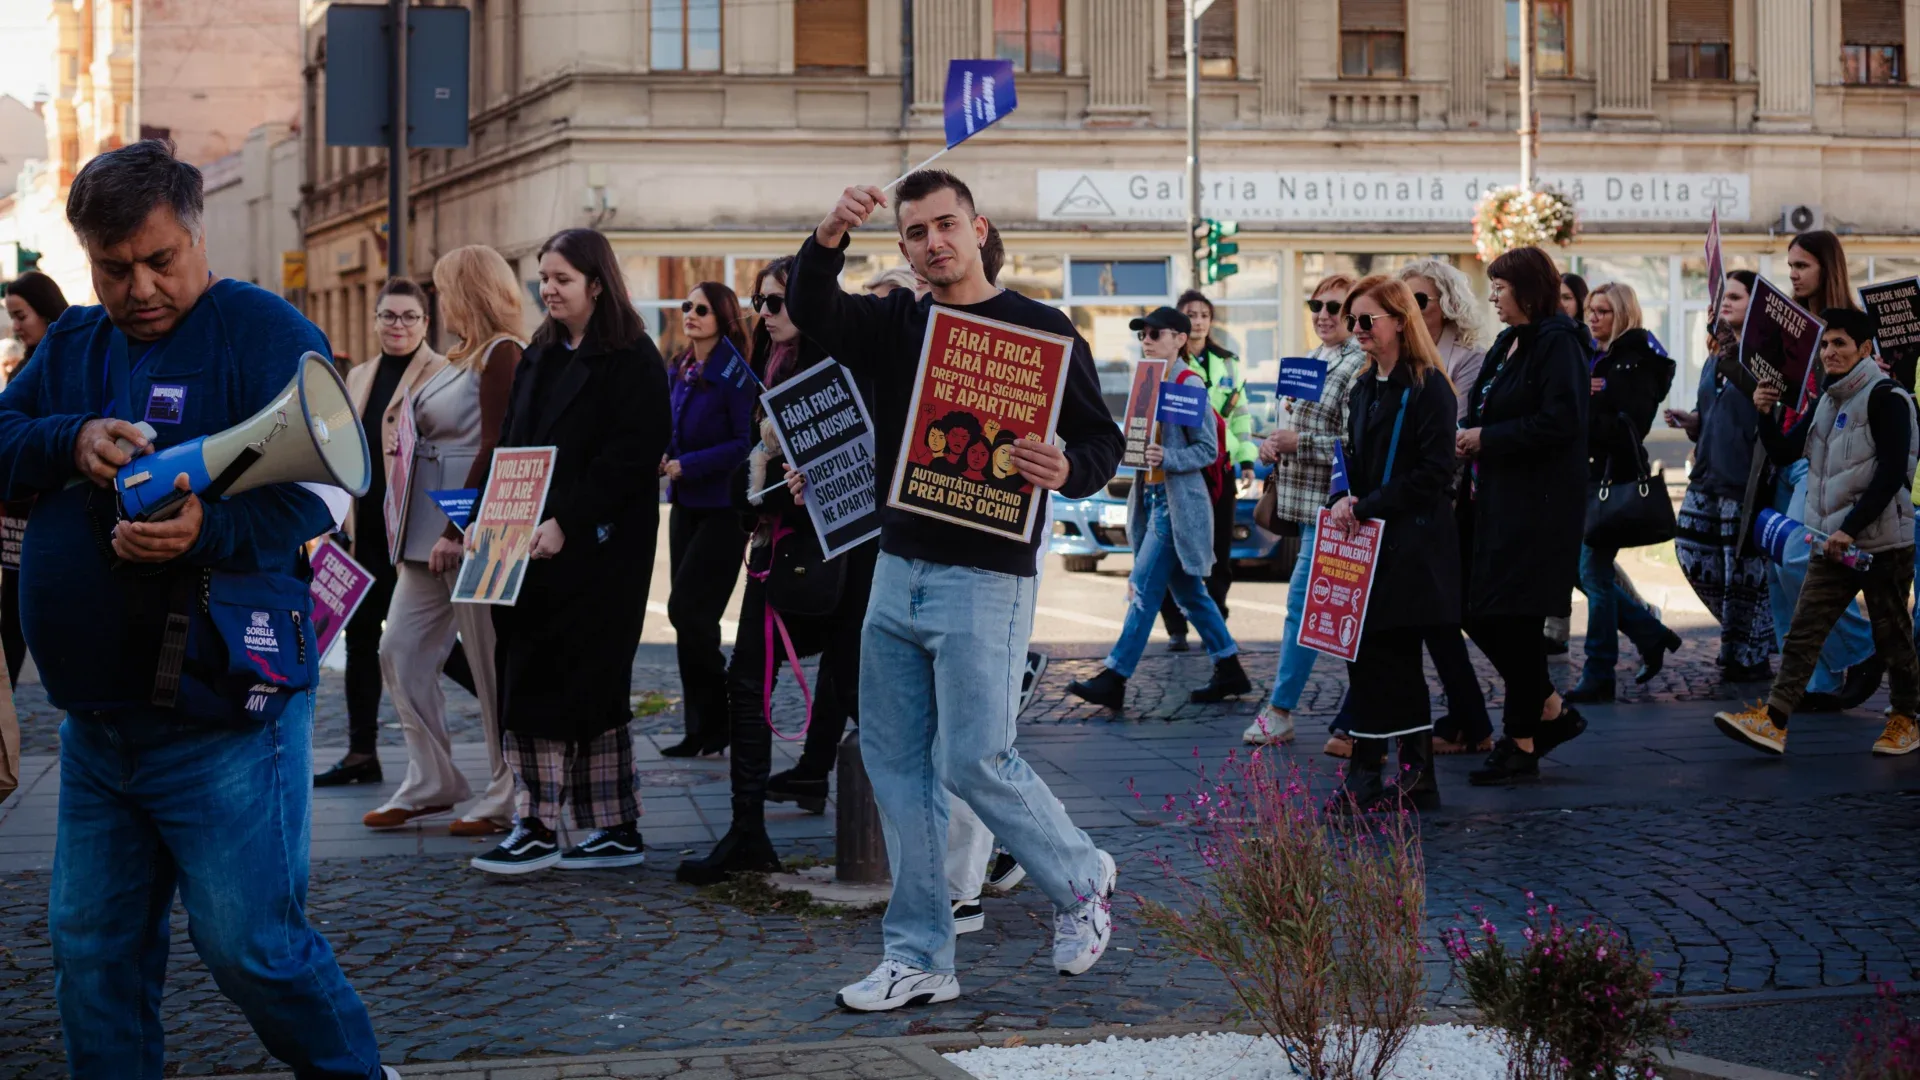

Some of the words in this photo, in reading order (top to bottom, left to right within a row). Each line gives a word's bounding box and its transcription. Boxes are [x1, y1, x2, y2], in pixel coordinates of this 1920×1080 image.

[1607, 177, 1690, 202] Delta
[1866, 290, 1895, 304] FIECARE
[1894, 286, 1917, 299] NUME
[1765, 304, 1802, 339] PENTRU
[1877, 325, 1906, 338] FIECARE
[947, 326, 992, 354] FĂRĂ
[994, 339, 1045, 370] FRICĂ,
[943, 348, 982, 374] FĂRĂ
[985, 359, 1043, 392] RUȘINE,
[931, 366, 977, 388] DREPTUL
[978, 380, 991, 392] LA
[991, 382, 1048, 409] SIGURANȚĂ
[933, 381, 954, 402] NE
[956, 390, 1038, 424] APARȚINE
[780, 396, 812, 430] FĂRĂ
[809, 378, 850, 414] FRICĂ,
[790, 423, 820, 455] FĂRĂ
[819, 405, 863, 442] RUȘINE,
[807, 452, 854, 486] DREPTUL
[853, 442, 869, 466] LA
[496, 482, 512, 500] NU
[908, 480, 944, 504] PREA
[946, 491, 973, 511] DES
[976, 499, 1020, 524] OCHII!
[911, 467, 983, 496] AUTORITĂȚILE
[983, 484, 1022, 507] ÎNCHID
[484, 501, 536, 520] CULOARE!
[821, 504, 837, 526] NE
[837, 483, 875, 517] APARȚIN
[1319, 540, 1338, 555] SUNT
[1321, 527, 1331, 539] NU
[1314, 584, 1329, 597] STOP
[243, 635, 279, 647] RAMONDA
[245, 626, 275, 637] SORELLE
[244, 694, 268, 712] MV
